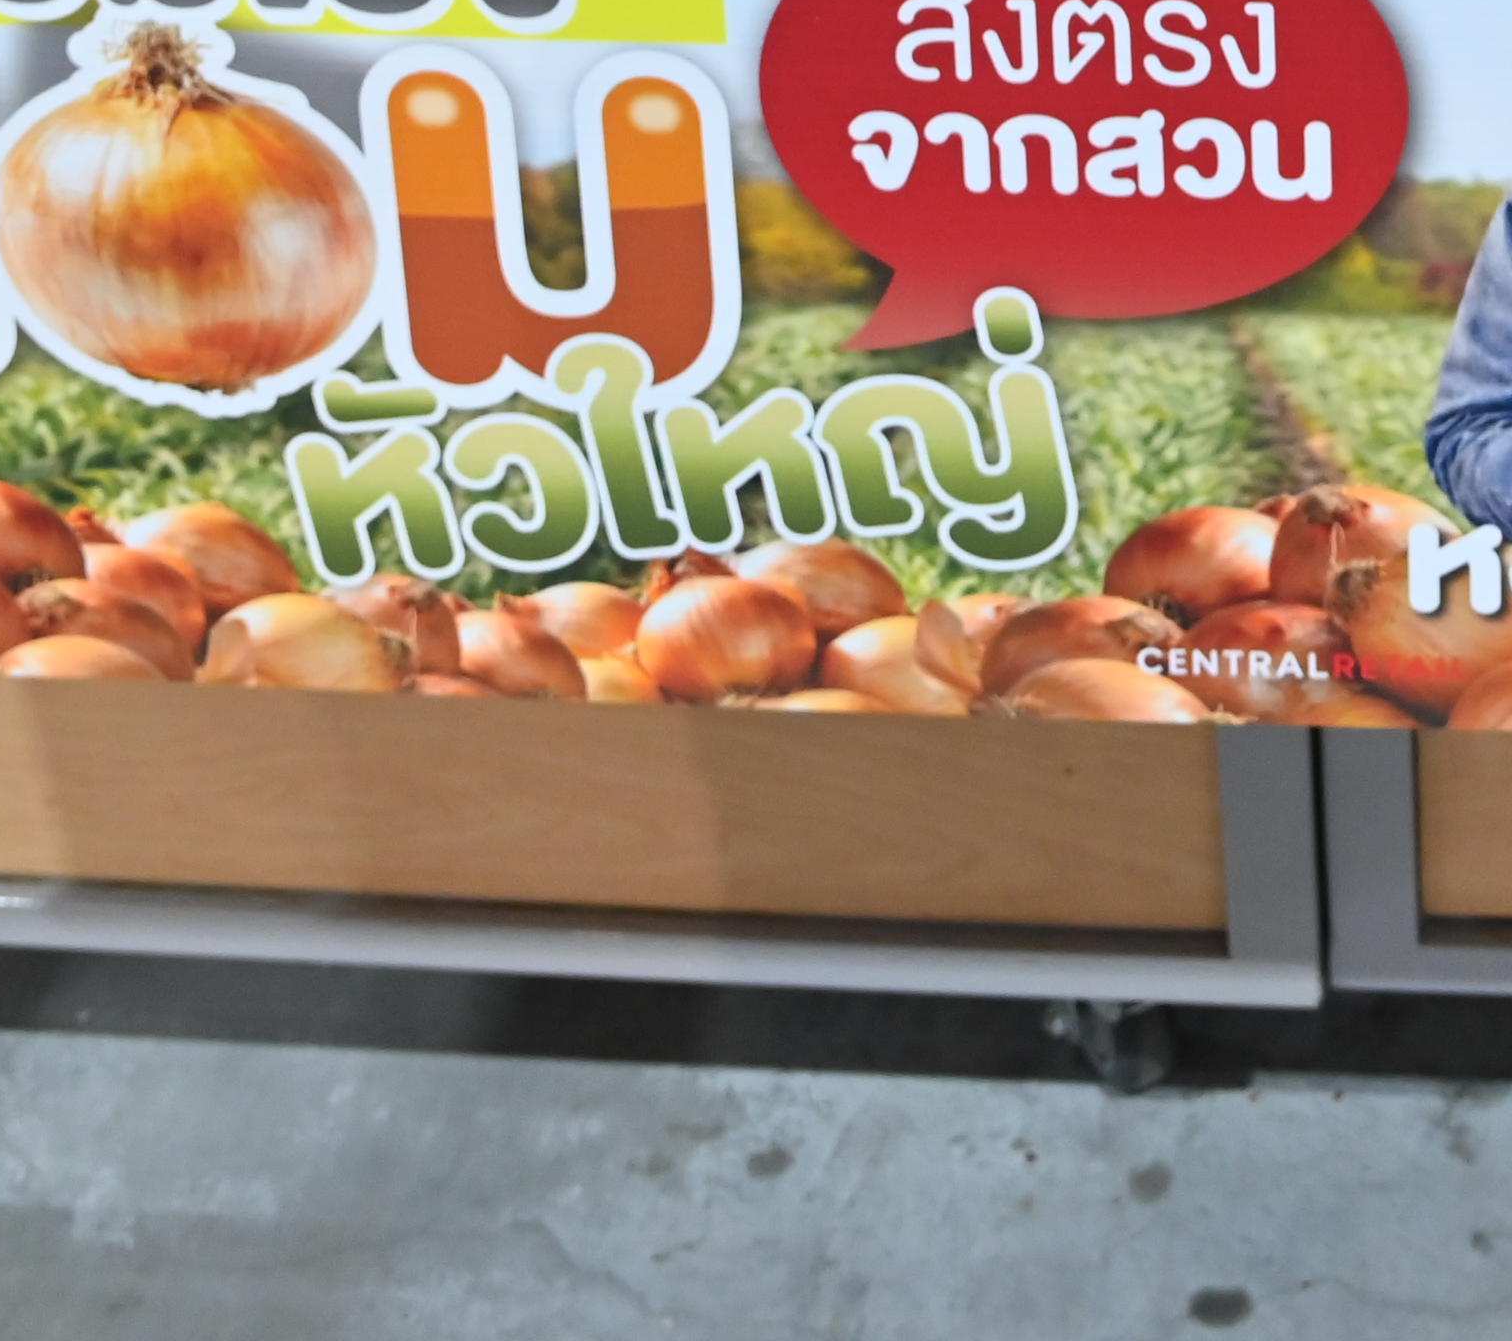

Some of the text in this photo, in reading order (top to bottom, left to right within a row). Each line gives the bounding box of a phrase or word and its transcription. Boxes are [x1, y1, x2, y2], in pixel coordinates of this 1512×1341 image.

[850, 99, 1336, 203] จากสวน
[288, 291, 1076, 585] หัวใหญ่
